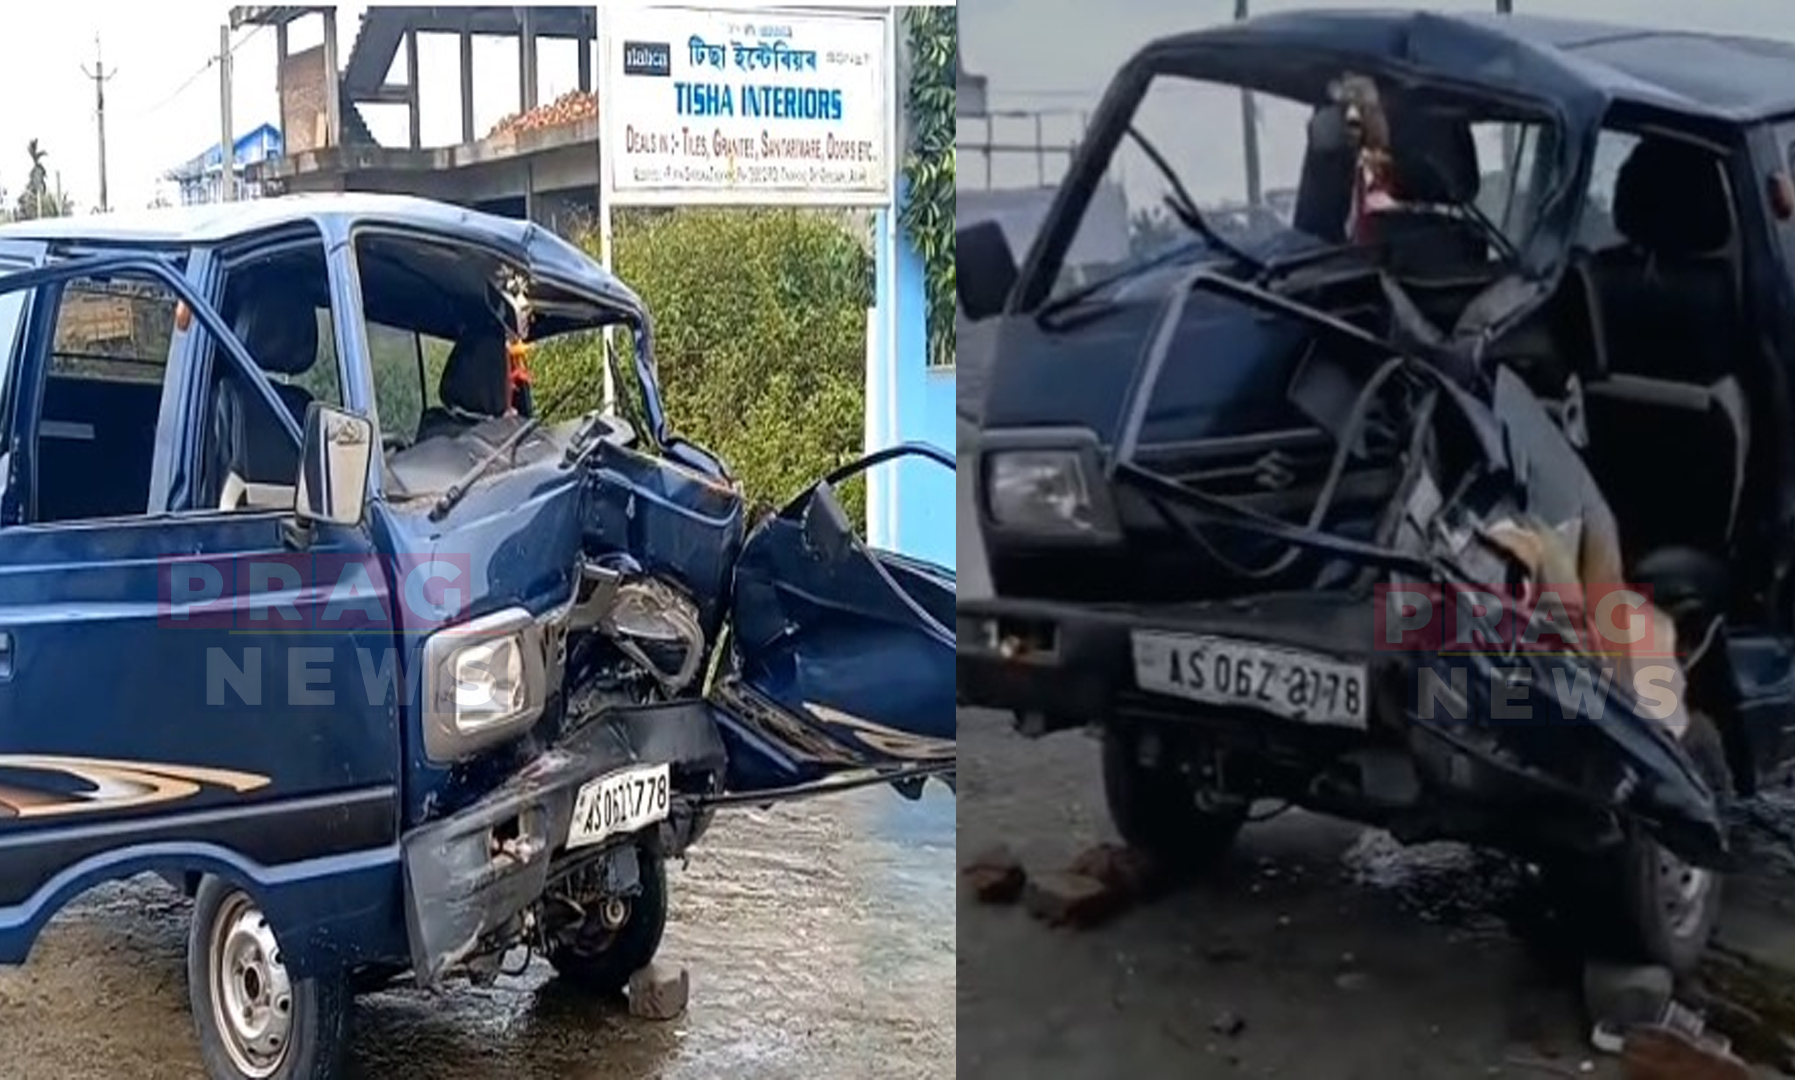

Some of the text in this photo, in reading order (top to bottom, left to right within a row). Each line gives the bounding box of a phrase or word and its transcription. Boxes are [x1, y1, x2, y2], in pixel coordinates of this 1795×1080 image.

[674, 82, 842, 120] TISHA INTERIORS
[626, 124, 657, 154] DEALS
